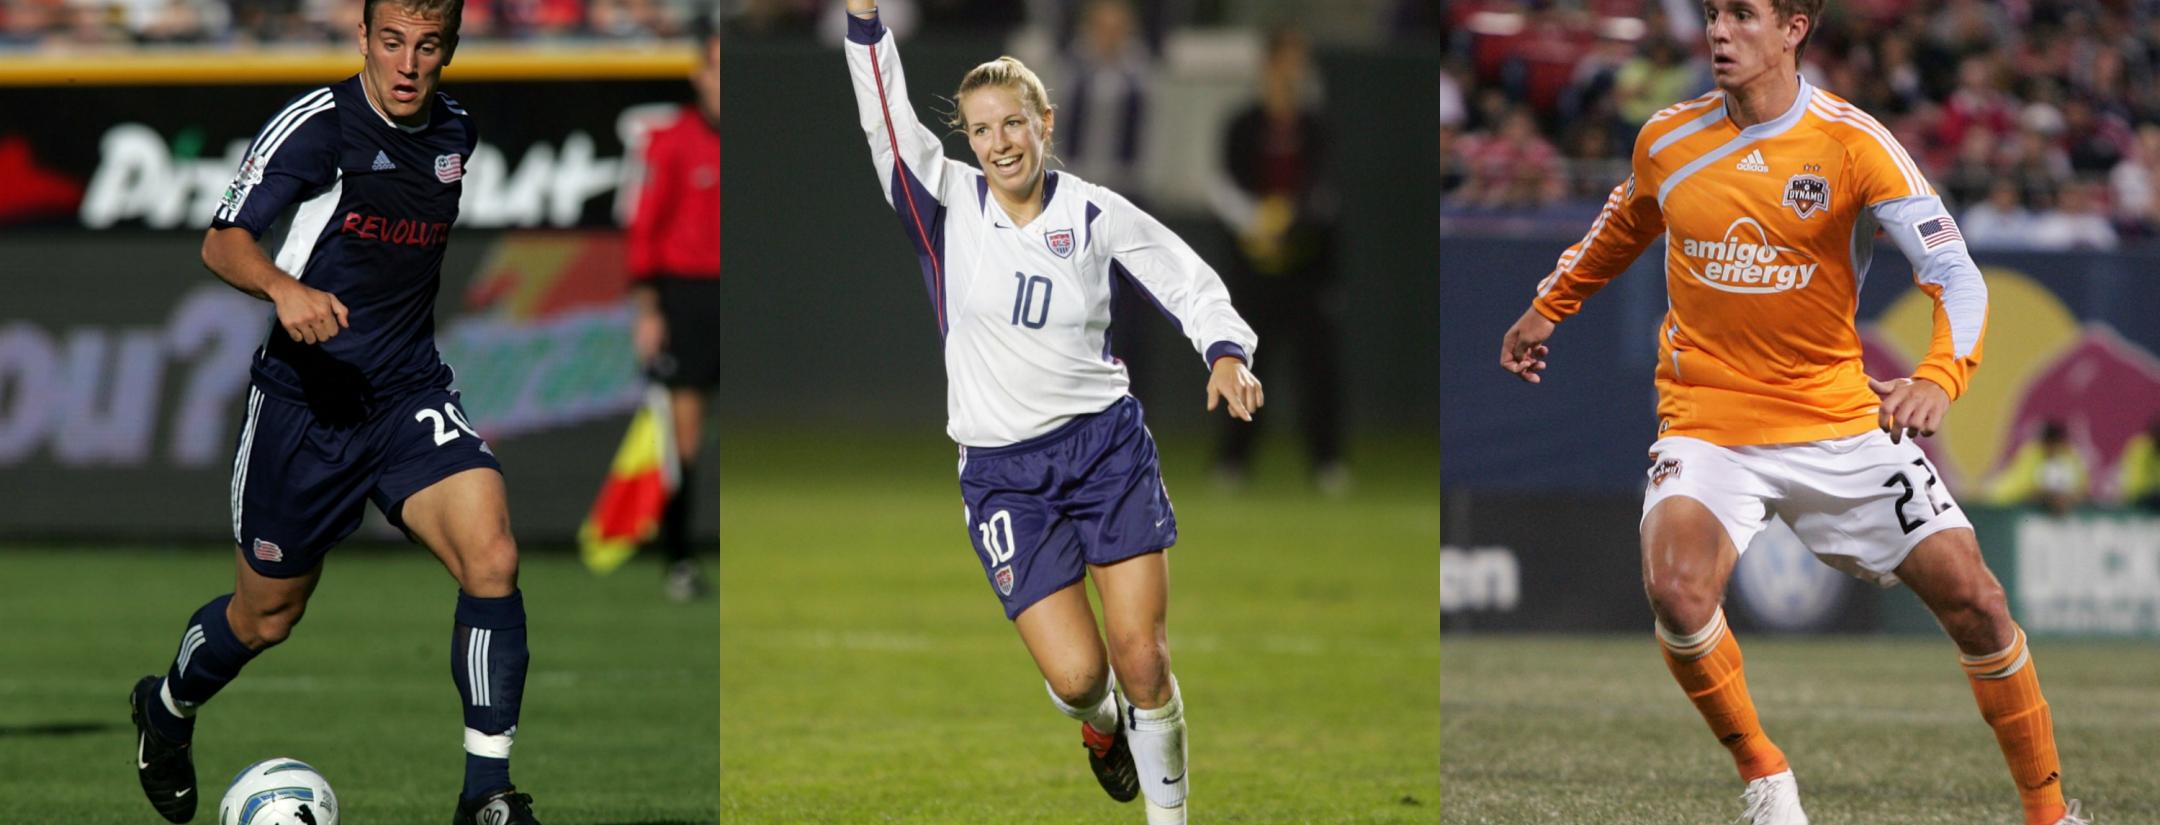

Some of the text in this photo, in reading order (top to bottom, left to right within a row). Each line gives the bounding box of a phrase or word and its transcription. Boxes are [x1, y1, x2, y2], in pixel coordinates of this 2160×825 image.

[1788, 189, 1824, 203] DYNAMO
[1683, 236, 1778, 269] amigo
[1704, 261, 1819, 290] energy
[1012, 271, 1053, 330] 10
[415, 402, 482, 447] 20
[1882, 458, 1953, 535] 22
[979, 510, 1015, 568] 10
